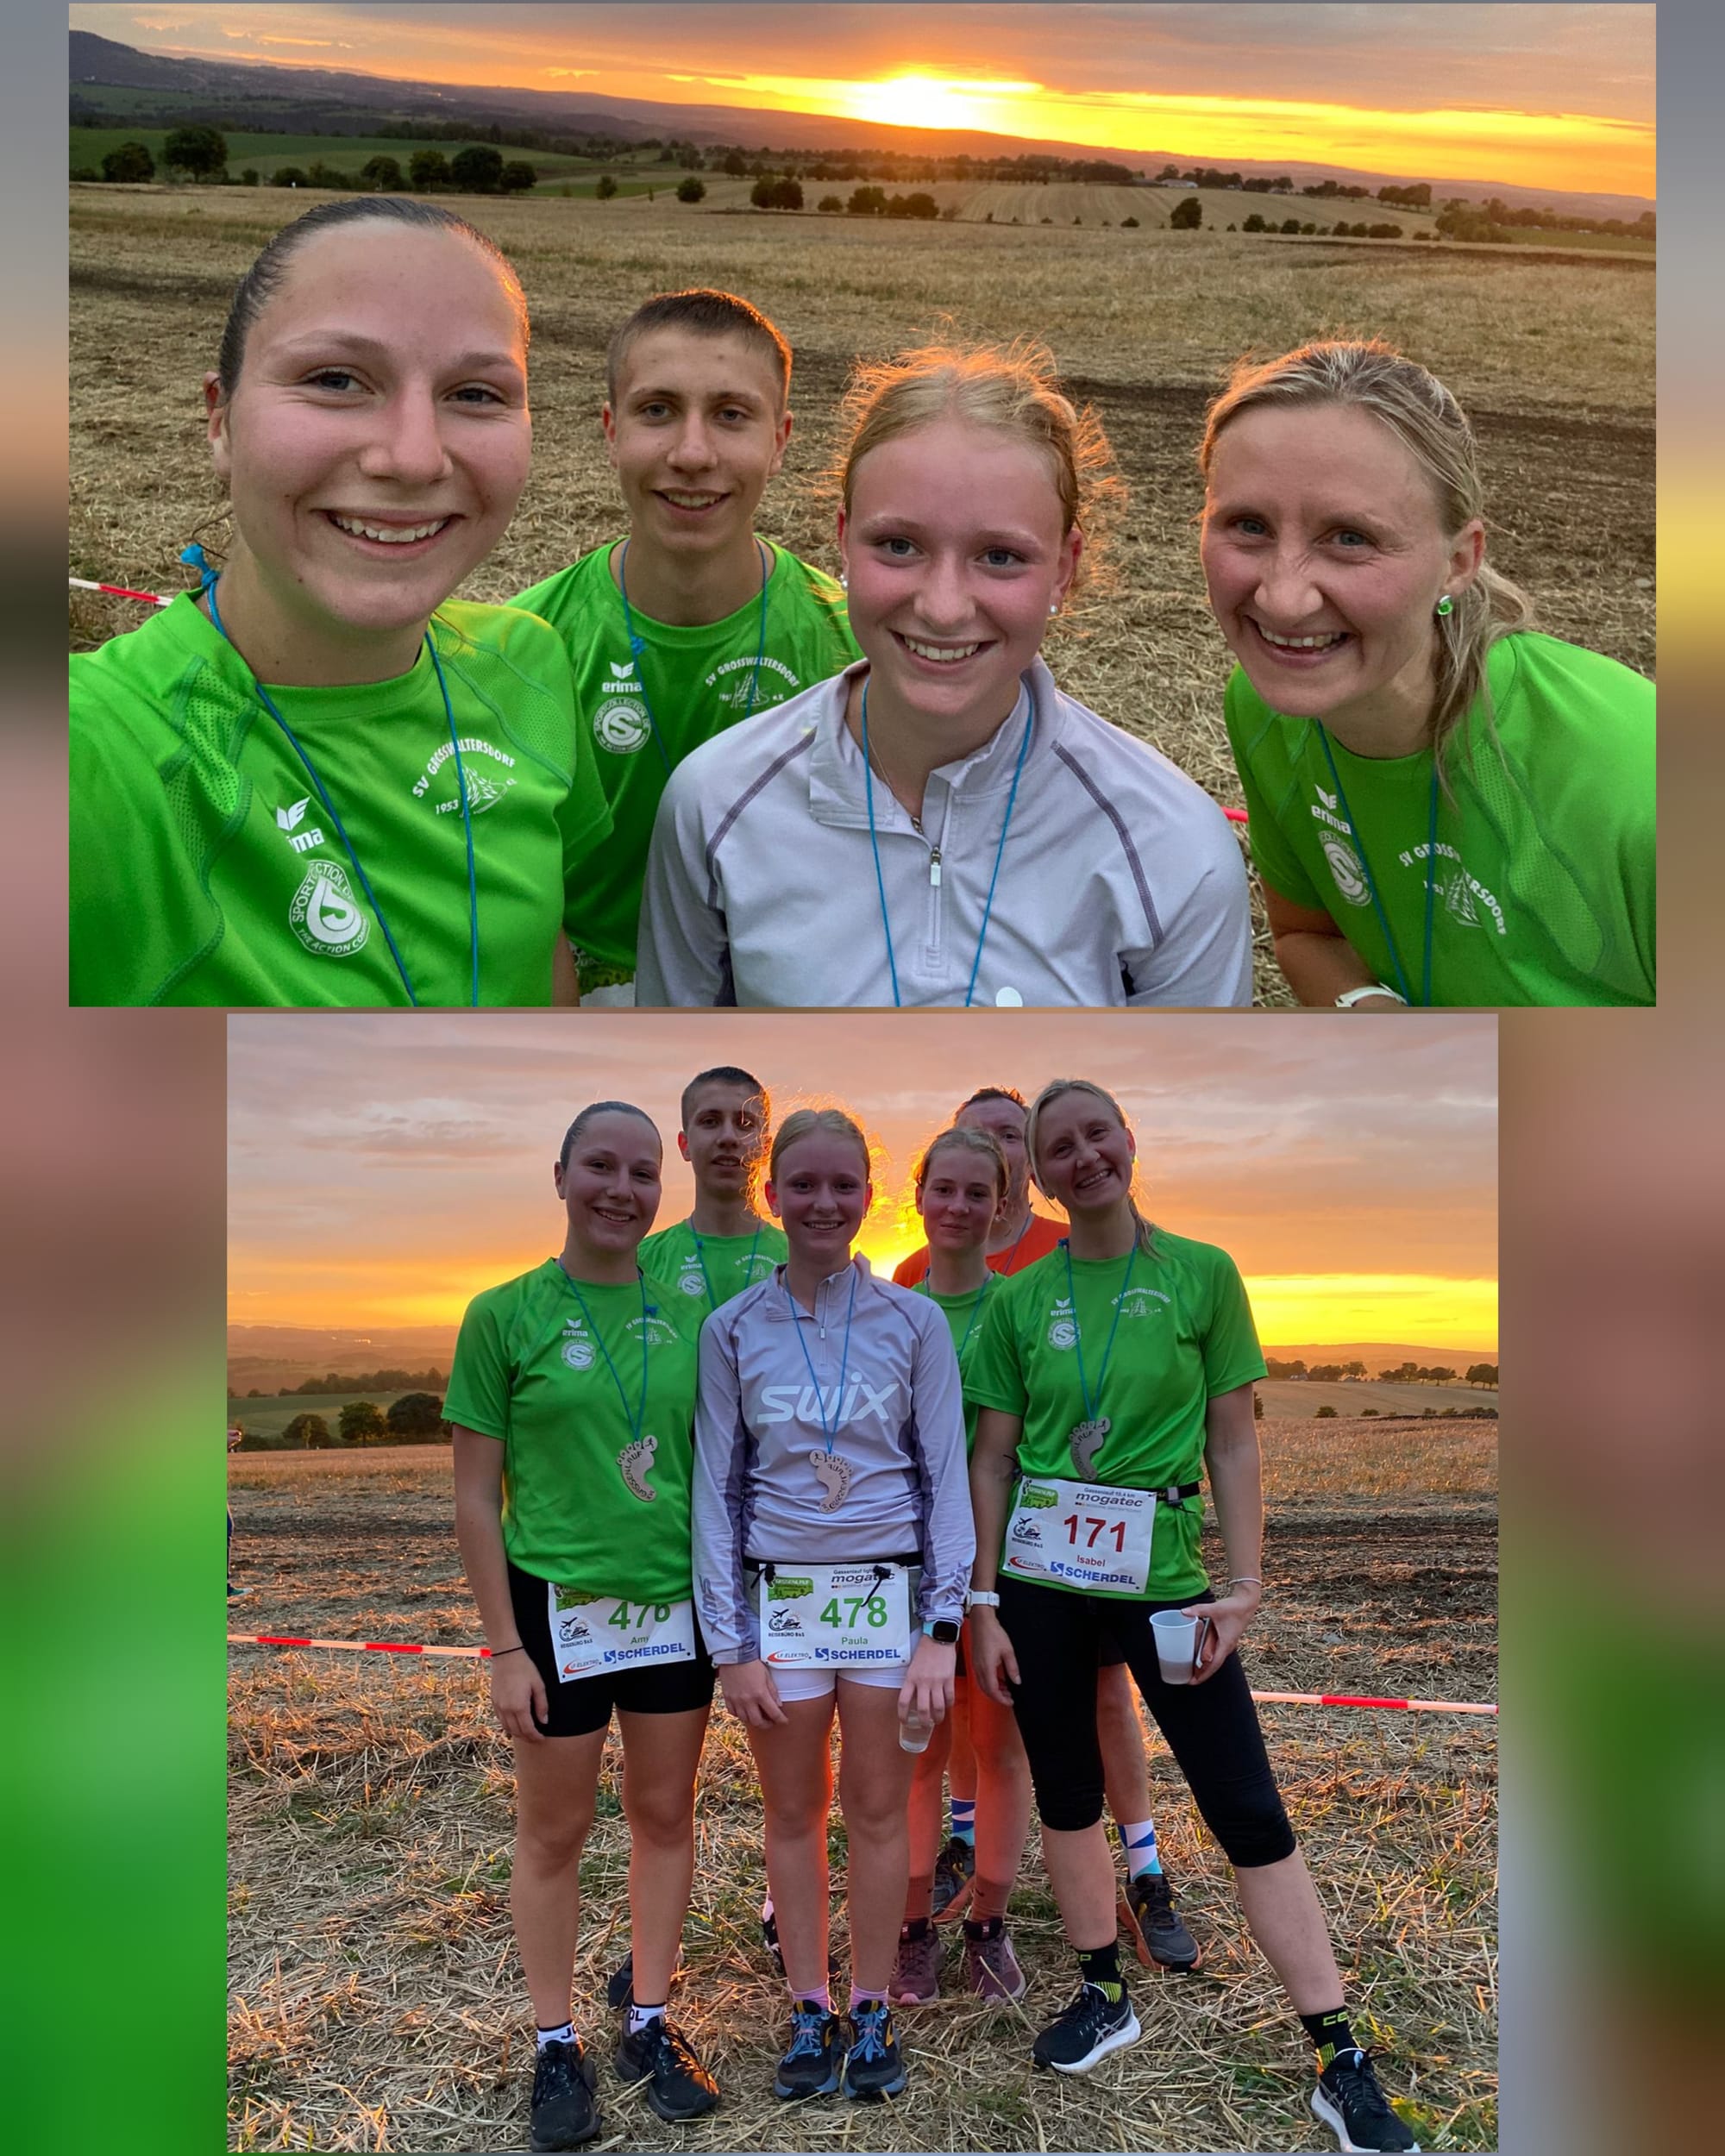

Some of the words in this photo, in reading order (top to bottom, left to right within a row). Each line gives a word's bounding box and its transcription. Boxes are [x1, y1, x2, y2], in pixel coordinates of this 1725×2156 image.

[602, 680, 643, 693] erima
[705, 673, 717, 686] SV
[412, 775, 430, 798] SV
[435, 799, 459, 815] 1953
[1310, 805, 1352, 836] erima
[1398, 850, 1414, 868] SV
[1075, 1492, 1144, 1507] mogatec
[1063, 1514, 1126, 1553] 171
[1076, 1554, 1106, 1567] Isabel
[1064, 1566, 1137, 1585] SCHERDEL
[819, 1595, 888, 1629] 478
[630, 1634, 649, 1646] Amy
[842, 1637, 869, 1645] Paula
[618, 1642, 687, 1661] SCHERDEL
[831, 1648, 901, 1660] SCHERDEL
